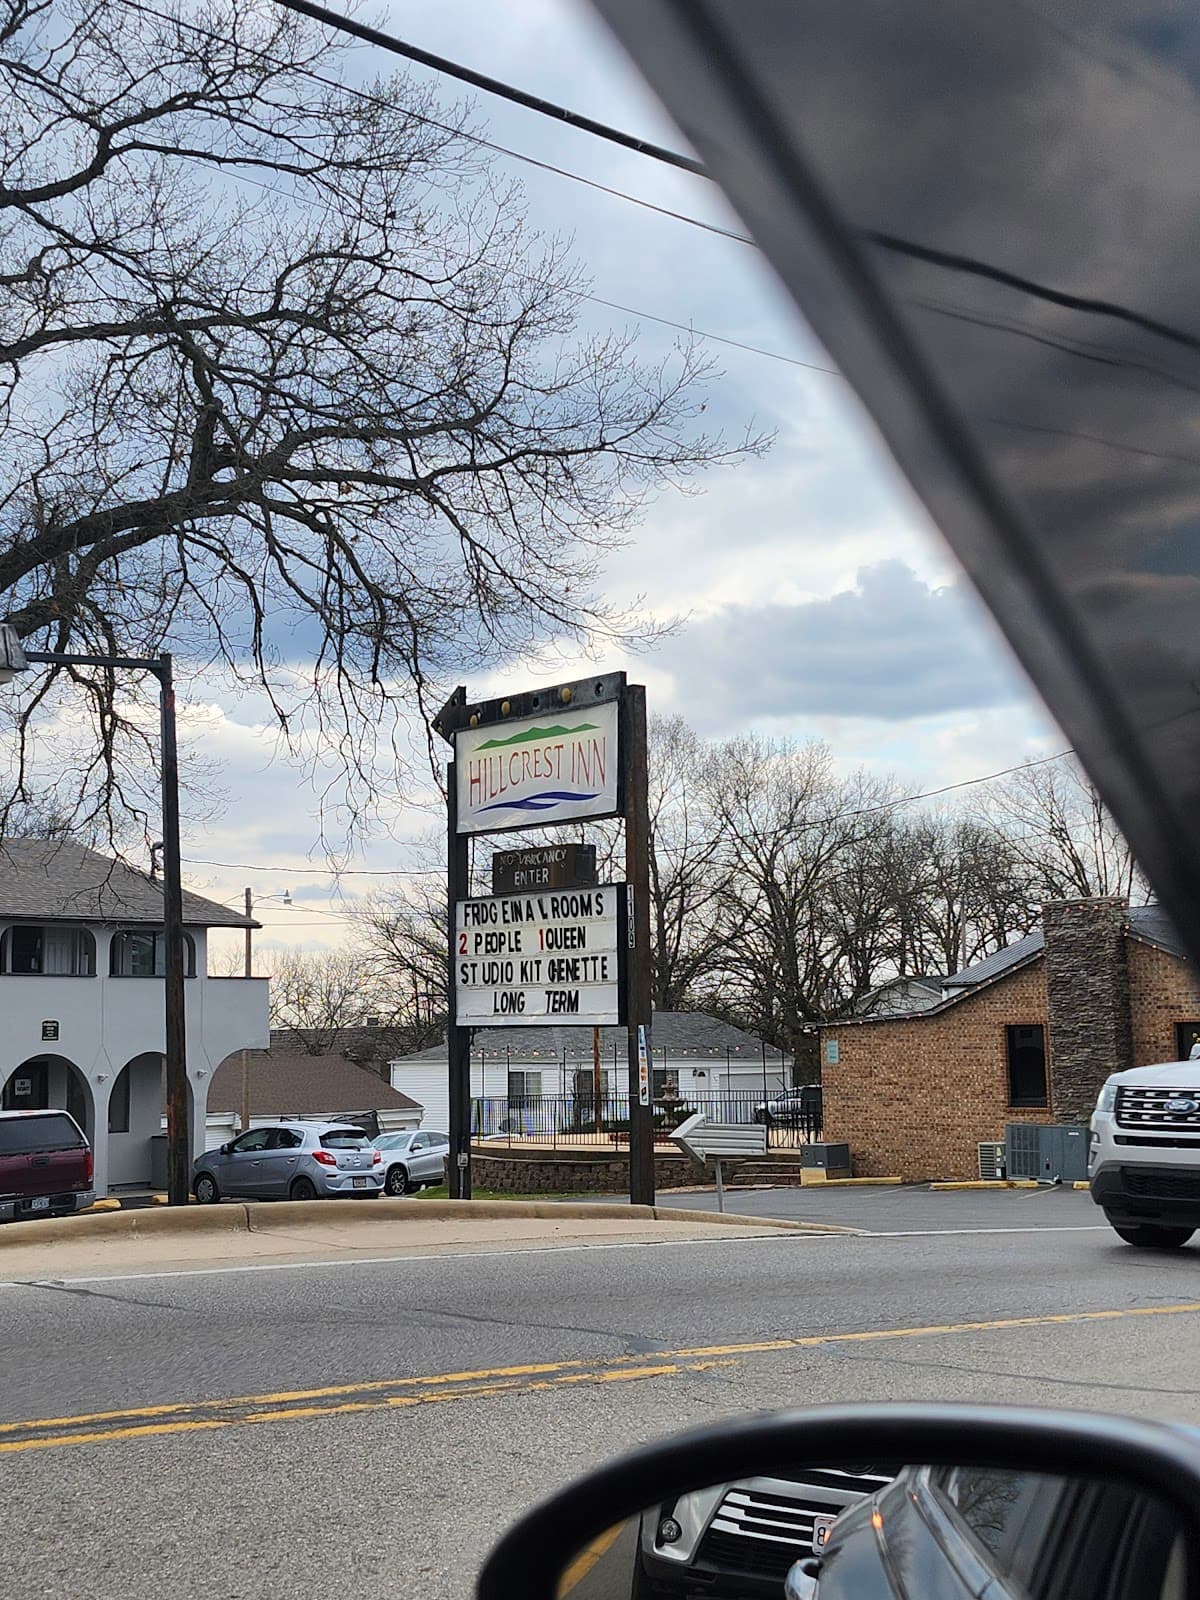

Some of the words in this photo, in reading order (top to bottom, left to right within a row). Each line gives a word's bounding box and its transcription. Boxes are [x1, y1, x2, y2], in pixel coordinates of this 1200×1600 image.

[469, 744, 564, 807] HILLCREST
[571, 736, 606, 788] INN
[514, 867, 549, 886] ENTER
[551, 893, 604, 919] ROOMS
[459, 933, 468, 955] 2
[474, 931, 522, 953] PEOPLE
[493, 991, 525, 1013] LONG
[545, 990, 579, 1013] TERM
